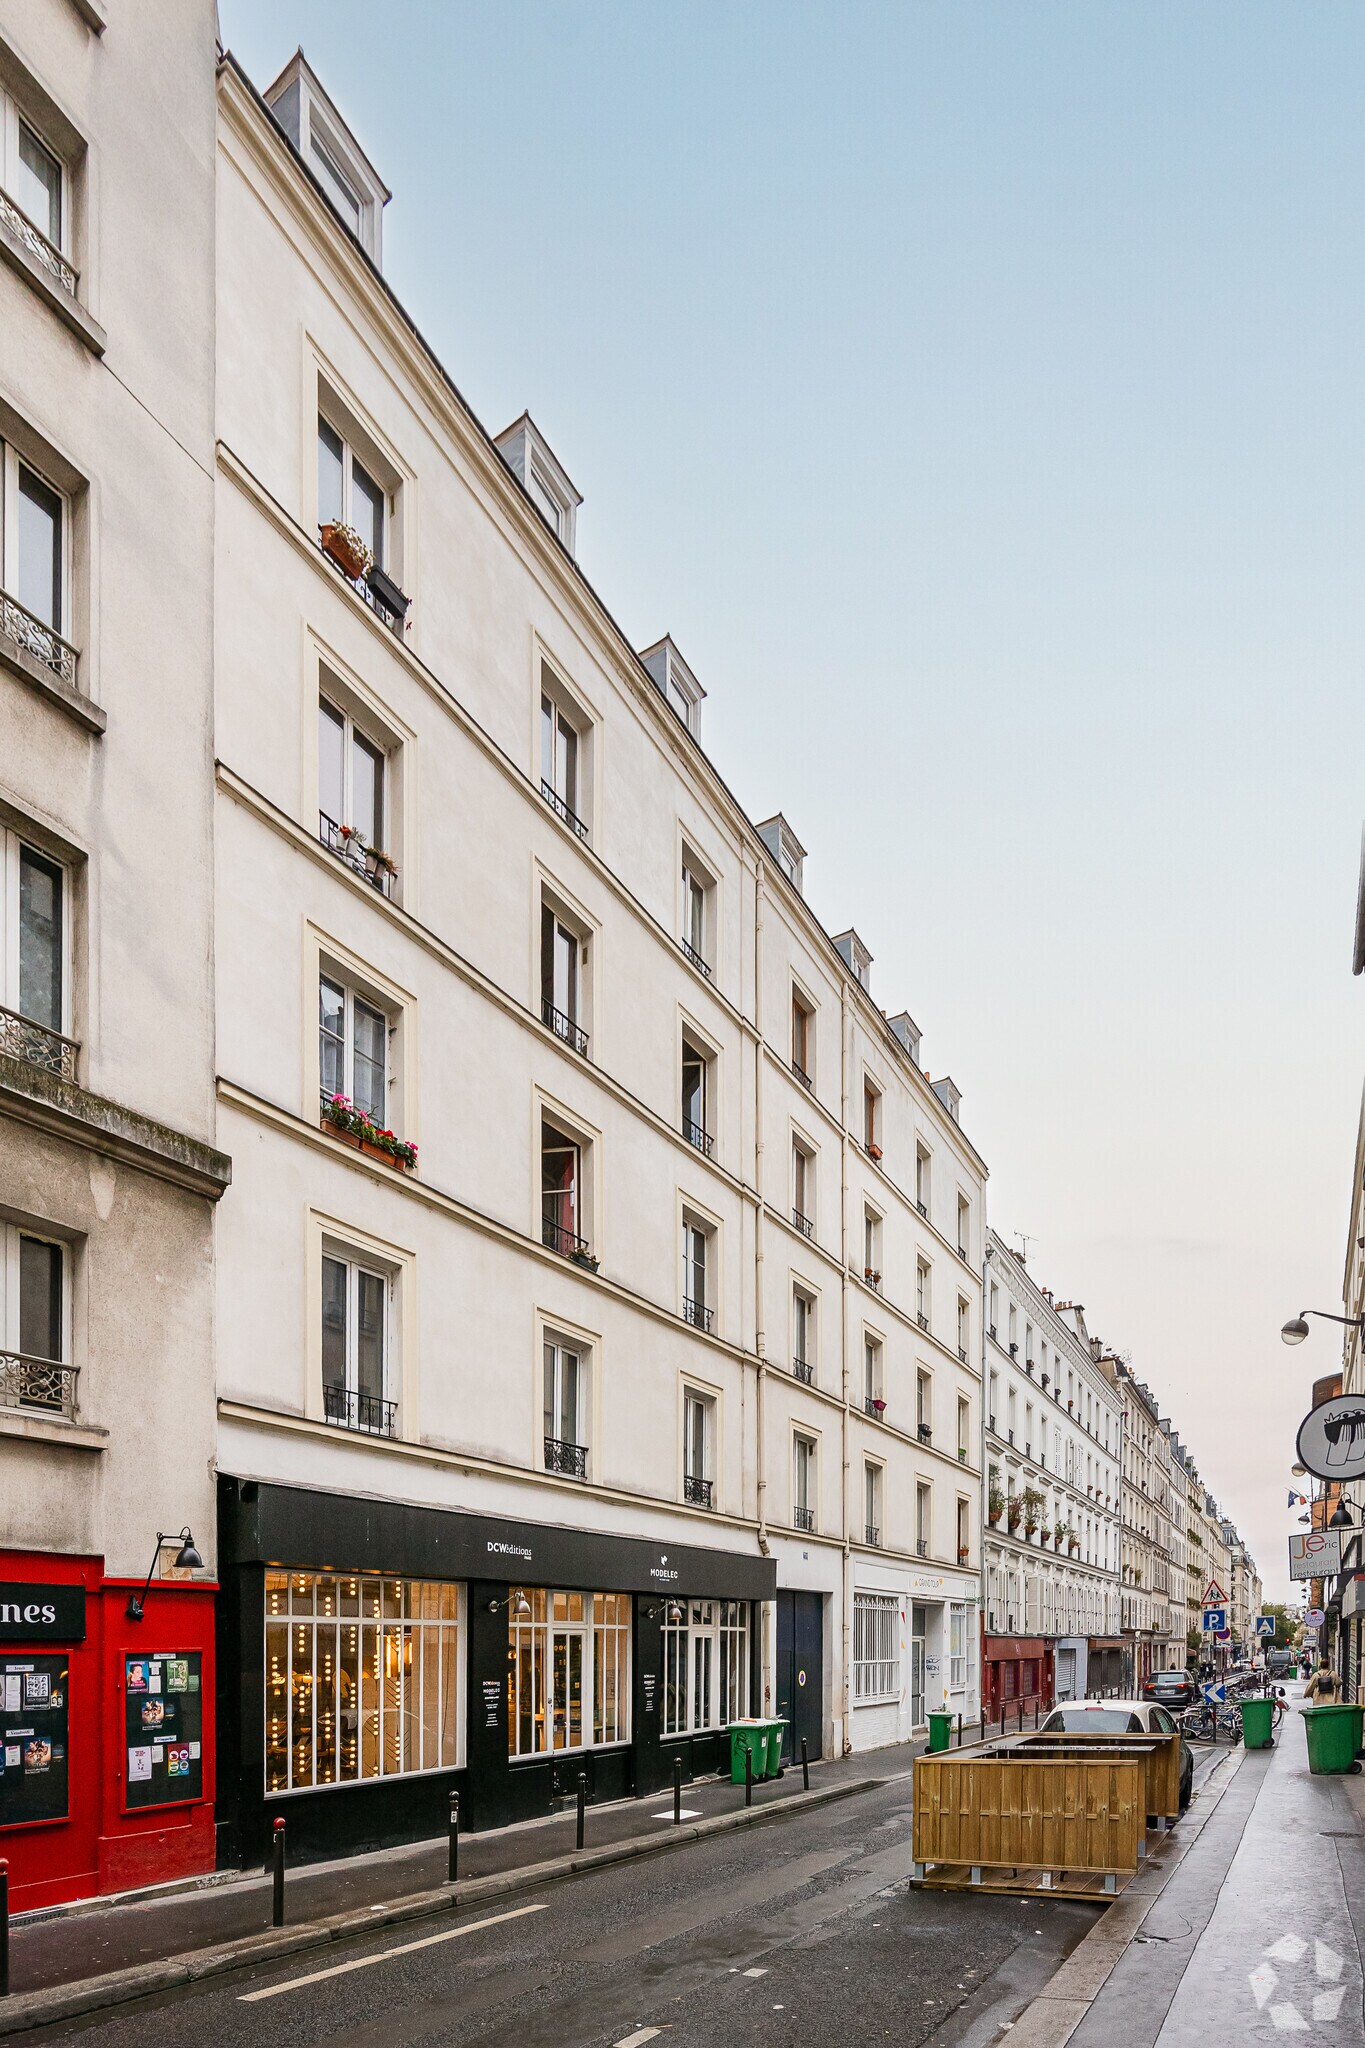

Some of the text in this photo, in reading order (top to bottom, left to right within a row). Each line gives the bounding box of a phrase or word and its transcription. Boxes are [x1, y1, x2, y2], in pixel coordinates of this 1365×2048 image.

[1293, 1559, 1338, 1570] restaurant
[650, 1568, 679, 1579] MODELEC
[1294, 1568, 1339, 1579] restaurant
[1209, 1613, 1220, 1628] P
